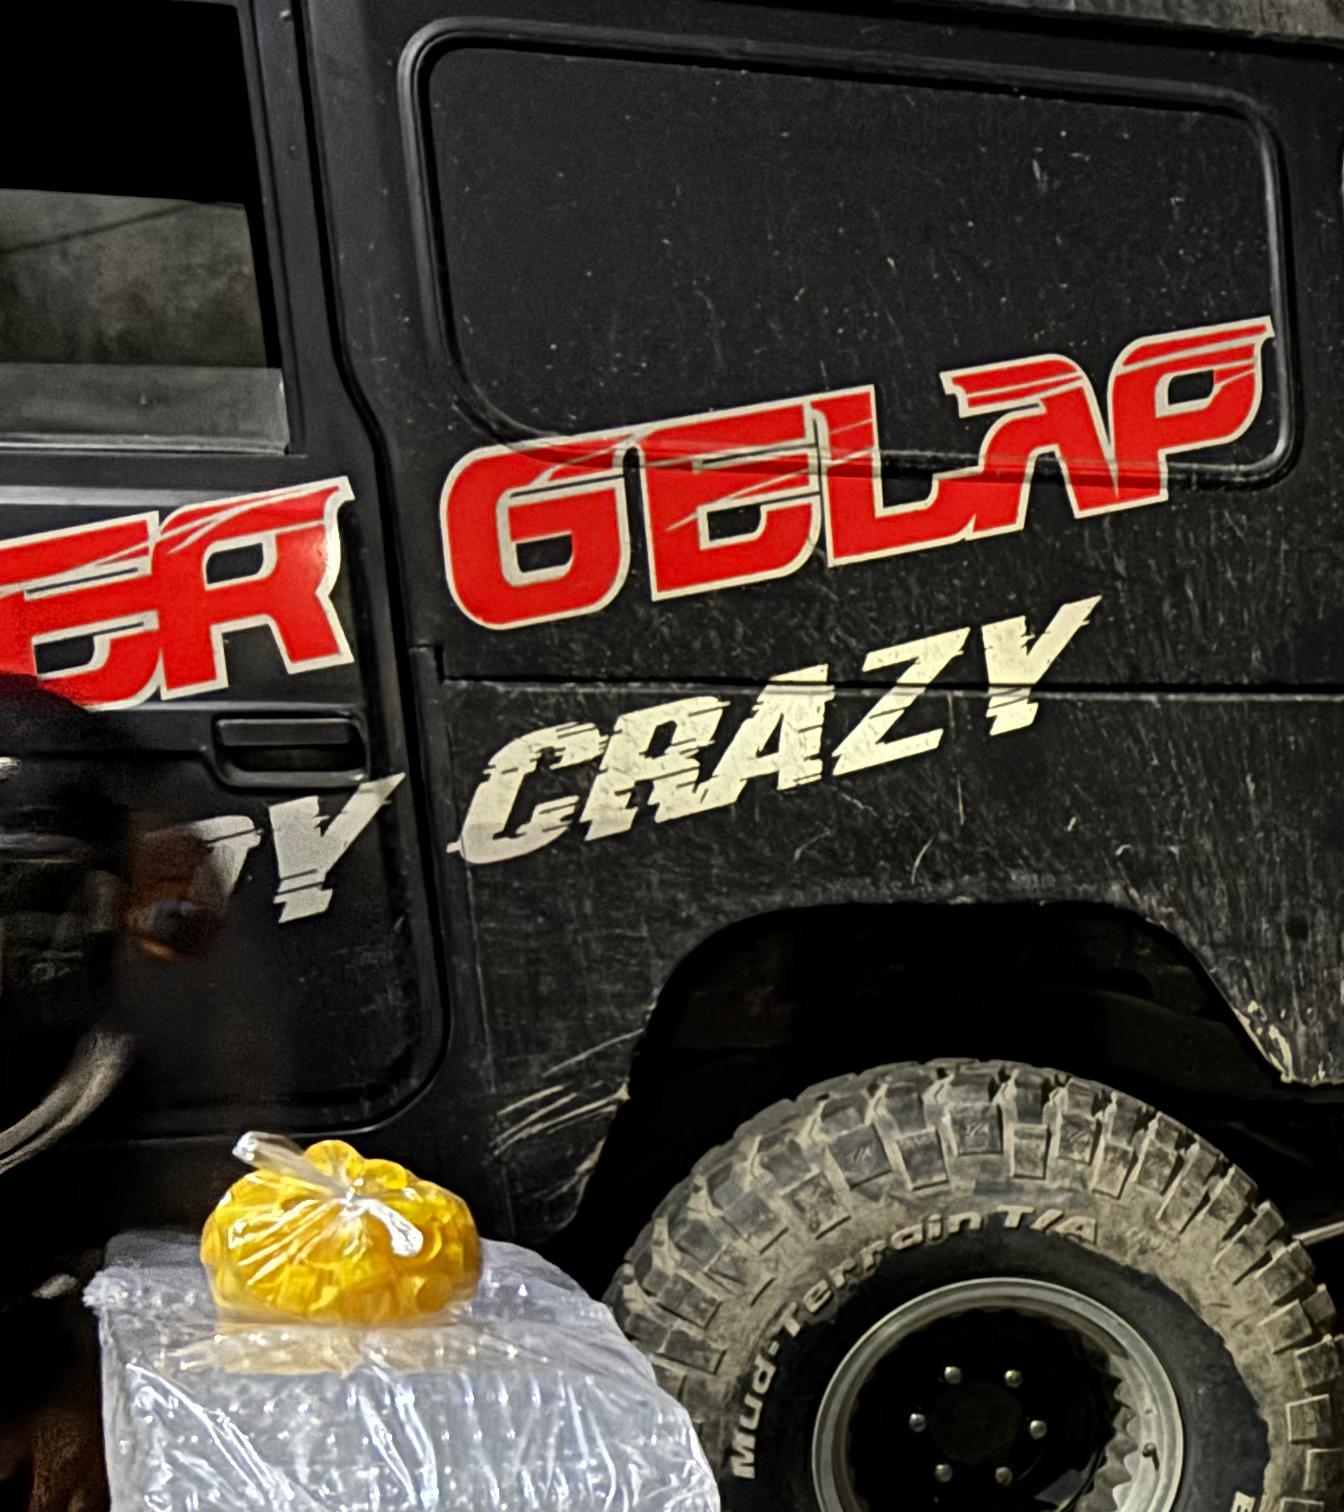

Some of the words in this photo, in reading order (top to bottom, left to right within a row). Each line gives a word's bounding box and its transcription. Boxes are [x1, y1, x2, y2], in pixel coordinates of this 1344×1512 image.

[439, 317, 1274, 630] GELAP
[447, 596, 1102, 864] CRAZY
[731, 1208, 983, 1480] Mud-Terrain
[996, 1204, 1101, 1246] T/A
